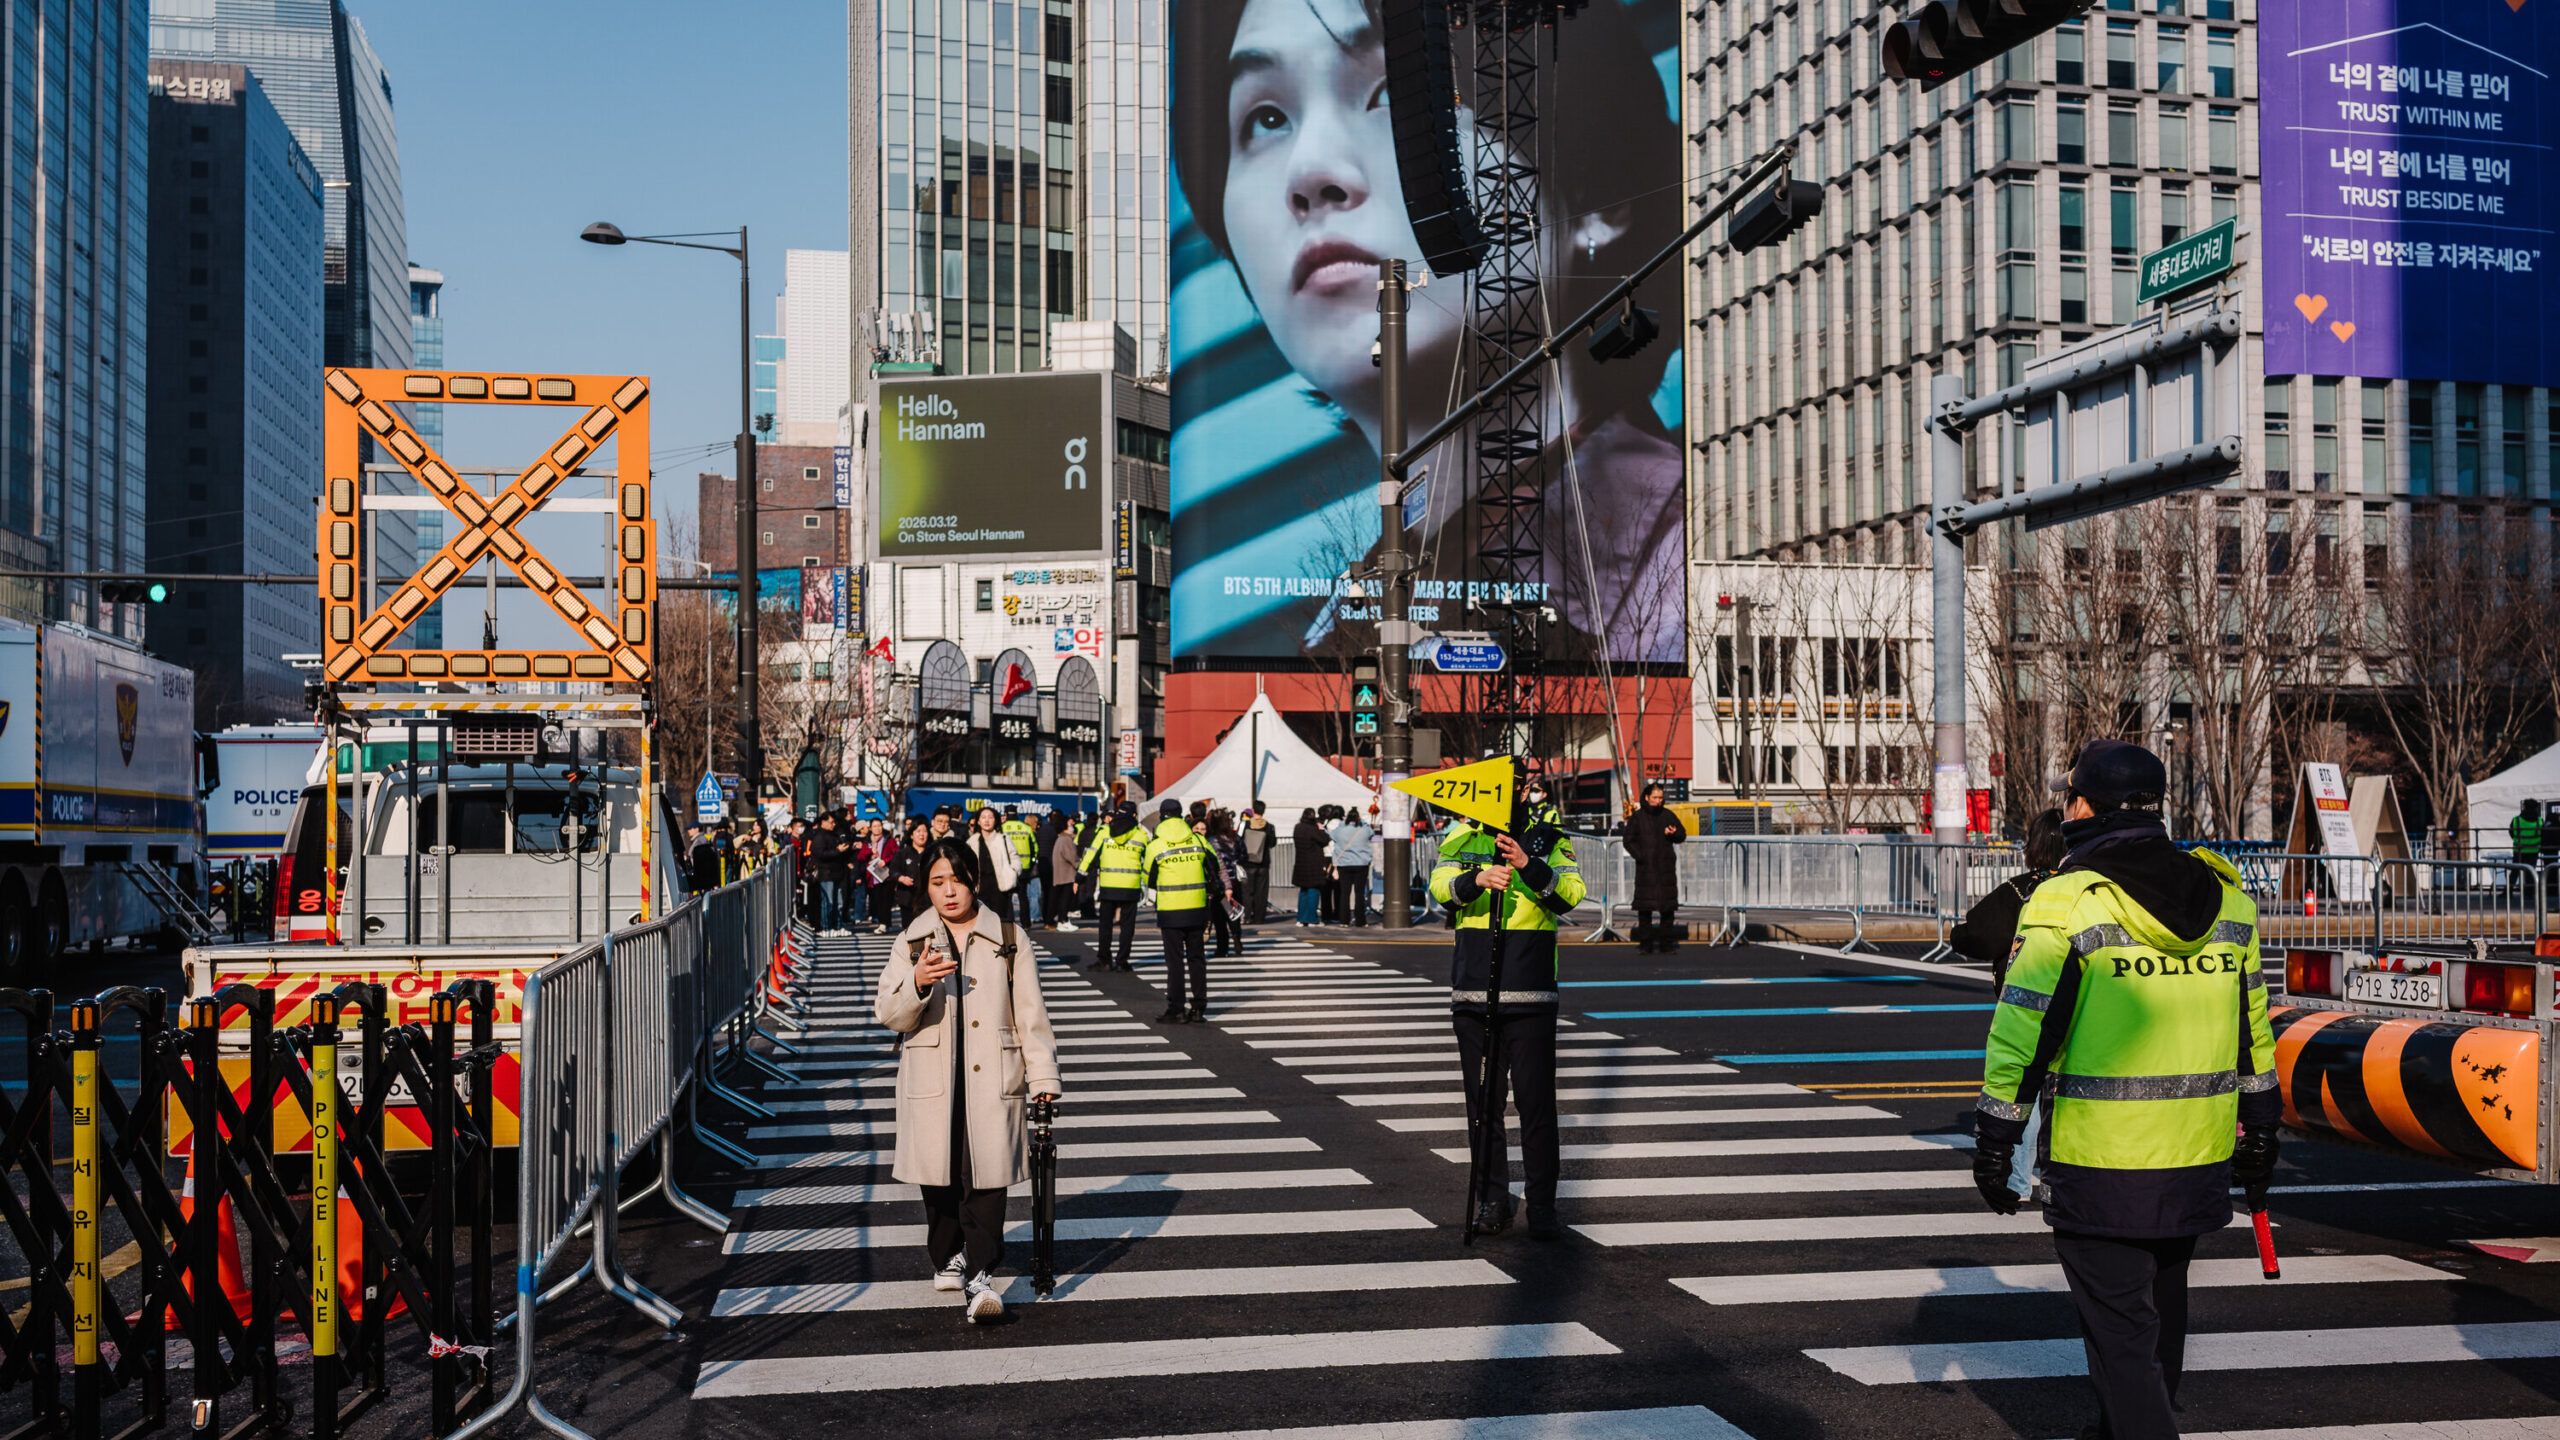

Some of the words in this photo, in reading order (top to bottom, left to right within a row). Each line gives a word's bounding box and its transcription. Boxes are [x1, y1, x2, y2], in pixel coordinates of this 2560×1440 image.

[2329, 62, 2372, 91] 너의
[2377, 65, 2420, 94] 곁에
[2424, 69, 2465, 98] 나를
[2470, 73, 2510, 102] 믿어
[2337, 101, 2401, 123] TRUST
[2406, 106, 2470, 129] WITHIN
[2474, 112, 2503, 131] ME
[2330, 147, 2372, 176] 나의
[2378, 150, 2421, 179] 곁에
[2426, 153, 2467, 181] 너를
[2472, 157, 2511, 185] 믿어
[2339, 186, 2401, 208] TRUST
[2406, 190, 2475, 211] BESIDE
[2478, 195, 2504, 214] ME
[2148, 233, 2223, 287] 세종대로사거리
[2373, 241, 2435, 267] 안전을
[898, 394, 958, 419] Hello,
[898, 419, 985, 441] Hannam
[835, 457, 849, 504] 한의원
[898, 515, 958, 528] 2026.03.12
[898, 531, 914, 543] On
[916, 530, 946, 542] Store
[947, 529, 979, 541] Seoul
[980, 529, 1024, 541] Hannam
[1224, 576, 1250, 595] BTS
[1254, 577, 1281, 595] 5TH
[1284, 578, 1332, 596] ALBUM
[1414, 581, 1444, 599] MAR
[1045, 614, 1092, 626] 피부과
[1453, 647, 1484, 655] 세종대로
[1355, 713, 1377, 733] 25
[1123, 733, 1136, 767] 약국
[2319, 768, 2332, 782] BTS
[234, 790, 298, 805] POLICE
[1433, 779, 1502, 802] 27기-1
[52, 795, 84, 821] POLICE
[2111, 953, 2237, 977] POLICE
[2356, 975, 2382, 997] 91오
[2390, 978, 2430, 1002] 3238
[314, 1102, 329, 1220] POLICE
[74, 1107, 92, 1332] 질서유지선
[317, 1245, 328, 1323] LINE
